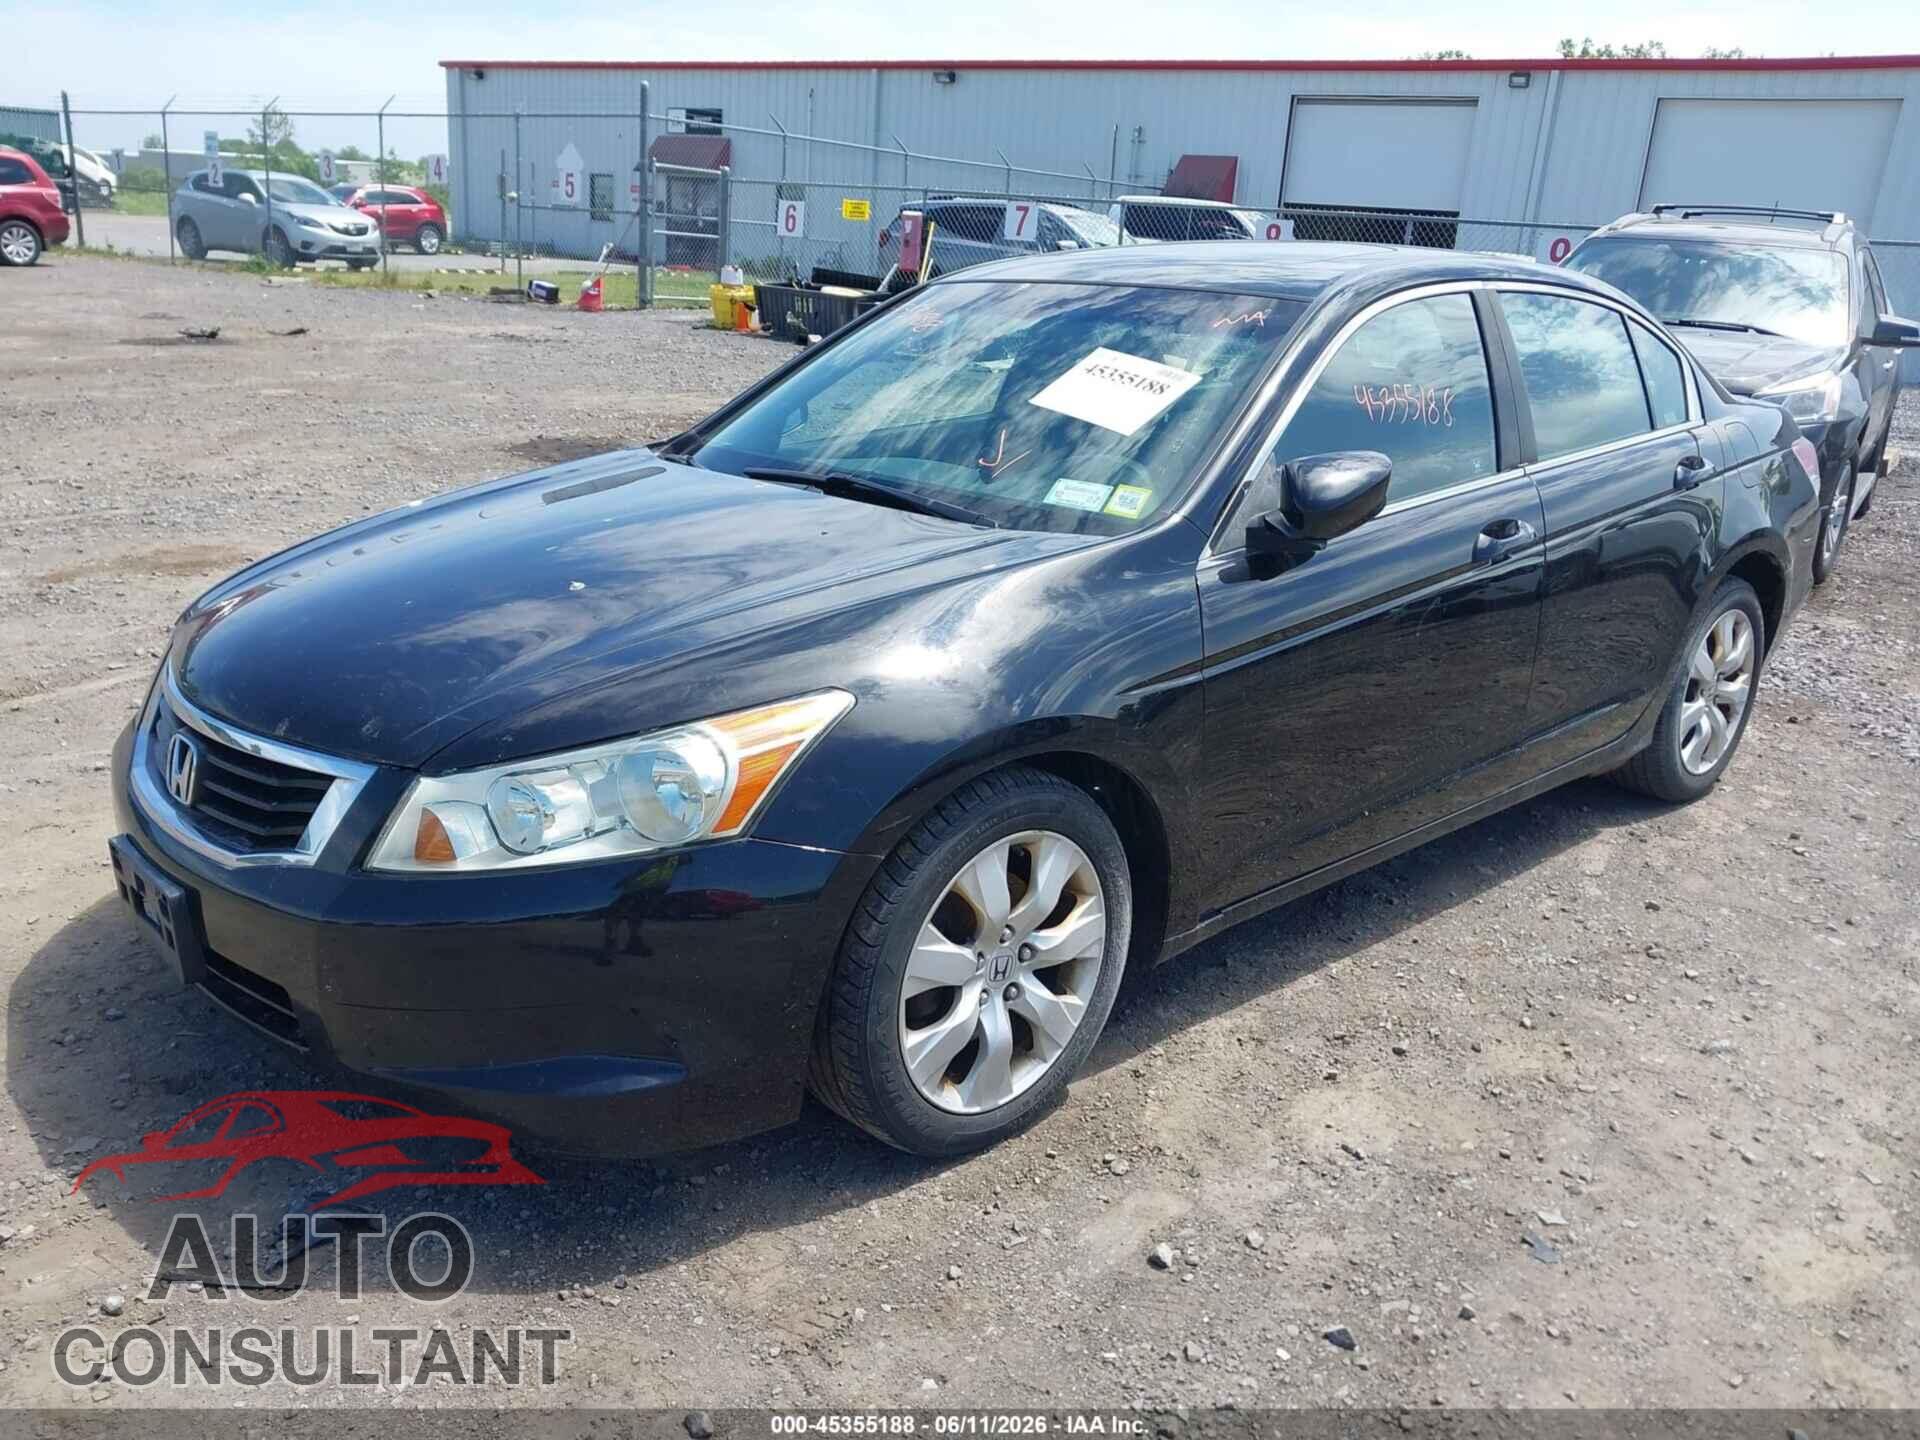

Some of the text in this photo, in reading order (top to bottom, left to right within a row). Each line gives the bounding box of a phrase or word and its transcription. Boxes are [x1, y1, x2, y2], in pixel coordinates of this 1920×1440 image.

[211, 163, 219, 184] 2
[324, 155, 332, 178] 3
[433, 156, 442, 181] 4
[564, 172, 575, 198] 5
[785, 204, 797, 233] 6
[1015, 205, 1030, 236] 7
[1085, 363, 1172, 396] 45355188
